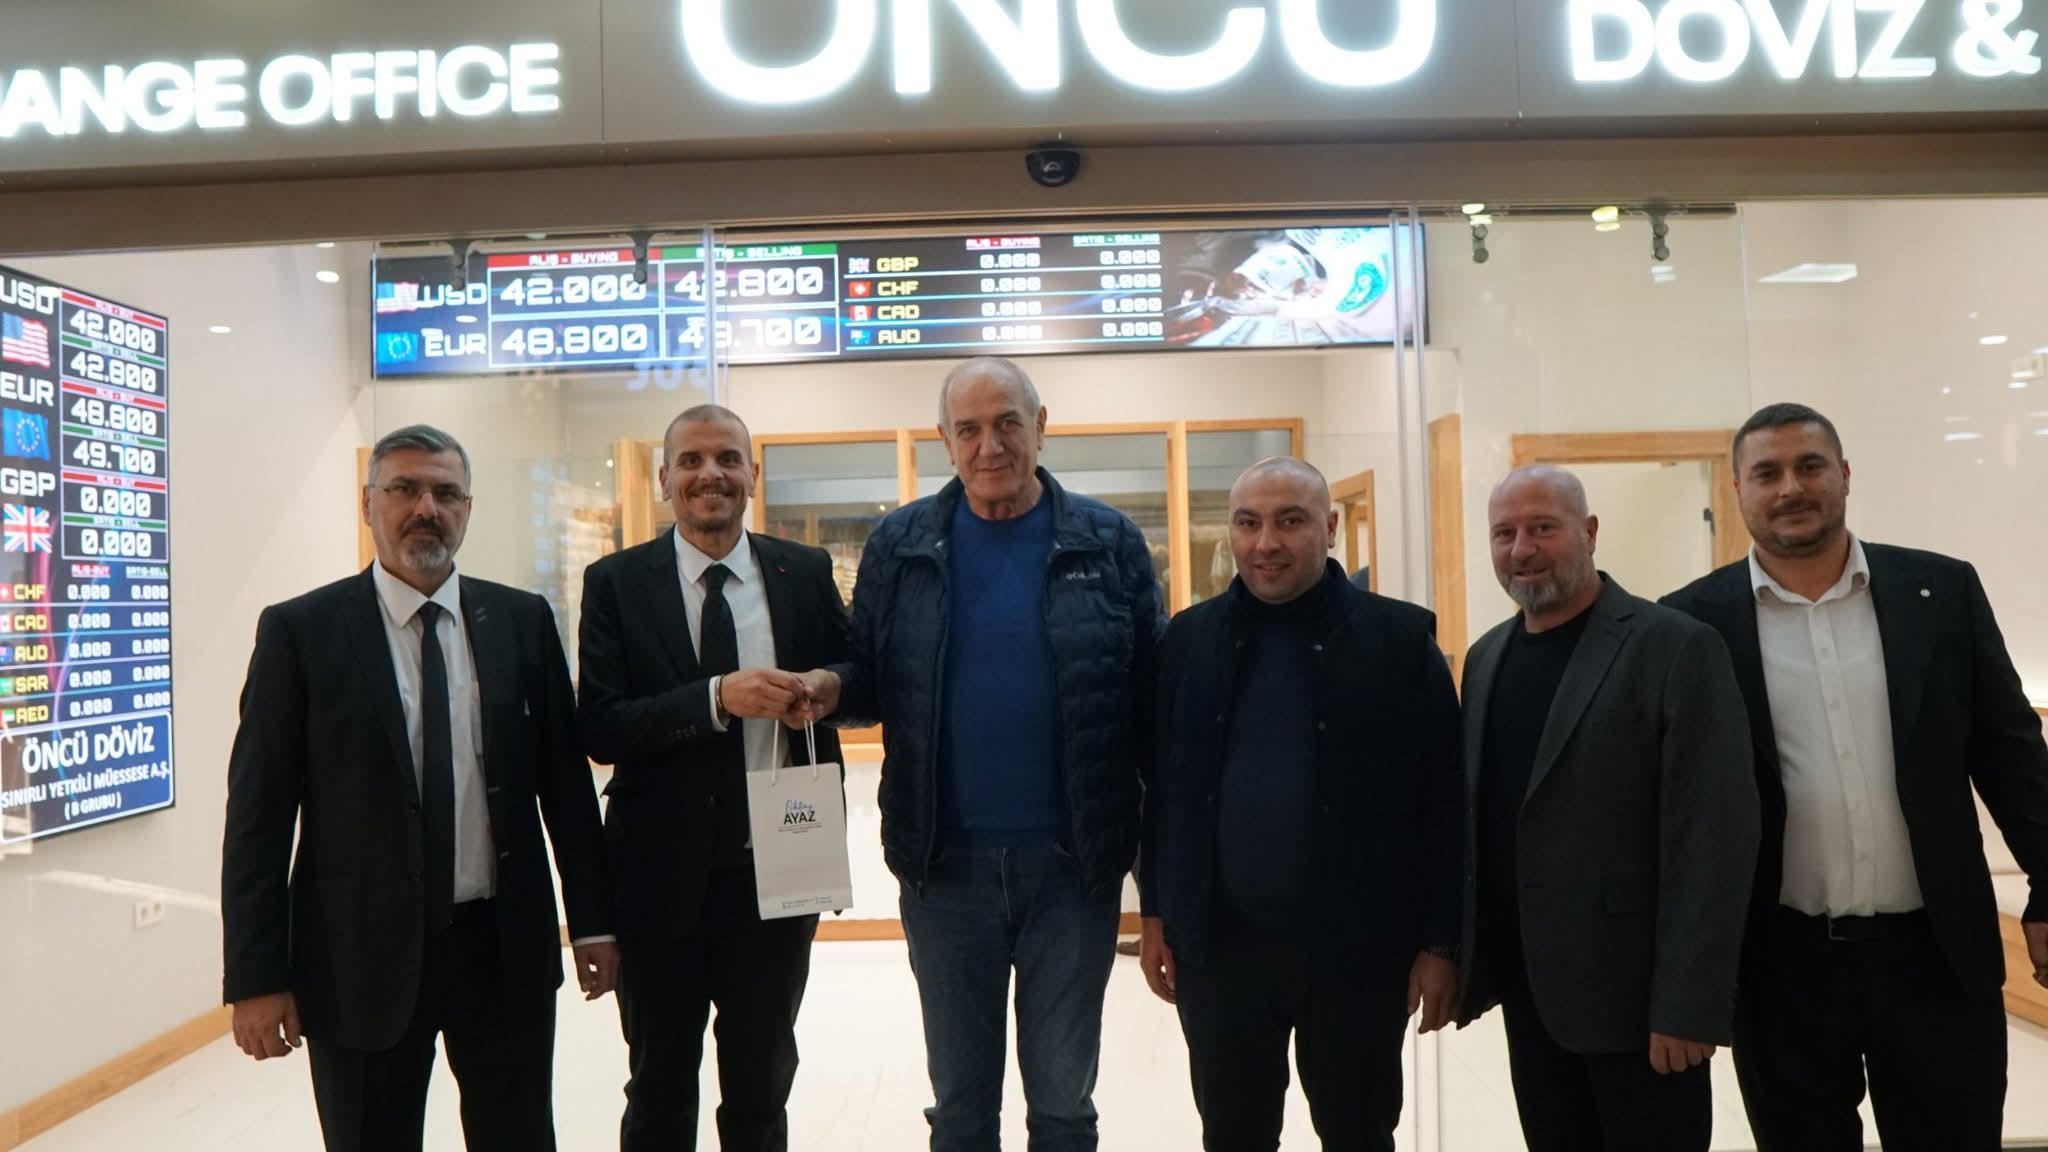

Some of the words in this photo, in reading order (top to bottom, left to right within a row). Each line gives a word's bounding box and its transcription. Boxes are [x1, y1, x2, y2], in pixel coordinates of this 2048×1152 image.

[259, 42, 561, 125] OFFICE
[876, 256, 919, 272] GBP
[0, 274, 54, 314] USD
[423, 282, 488, 308] USD
[500, 273, 647, 307] 42.000
[877, 280, 919, 297] CHF
[877, 304, 920, 320] CAD
[70, 309, 156, 354] 42.000
[424, 332, 488, 357] EUR
[501, 323, 648, 356] 48.800
[878, 328, 921, 344] AUD
[70, 351, 157, 393] 42.800
[0, 371, 54, 407] EUR
[70, 397, 157, 436] 48.800
[72, 440, 156, 476] 49.700
[0, 467, 56, 497] GBP
[80, 486, 151, 518] 0.000
[81, 528, 152, 557] 0.000
[13, 584, 47, 600] CHF
[67, 584, 110, 600] 0.000
[131, 585, 169, 600] 0.000
[14, 613, 48, 631] CAD
[68, 613, 111, 629] 0.000
[131, 612, 169, 627] 0.000
[15, 644, 48, 662] AUD
[132, 638, 169, 655] 0.000
[15, 675, 49, 693] SAR
[69, 669, 112, 688] 0.000
[133, 665, 170, 682] 0.000
[16, 705, 49, 724] AED
[70, 698, 113, 717] 0.000
[133, 691, 171, 709] 0.000
[22, 730, 89, 774] ÖNCÜ
[94, 722, 156, 761] DÖVİZ
[93, 767, 149, 790] MÜESSESE
[783, 810, 817, 825] AYAZ
